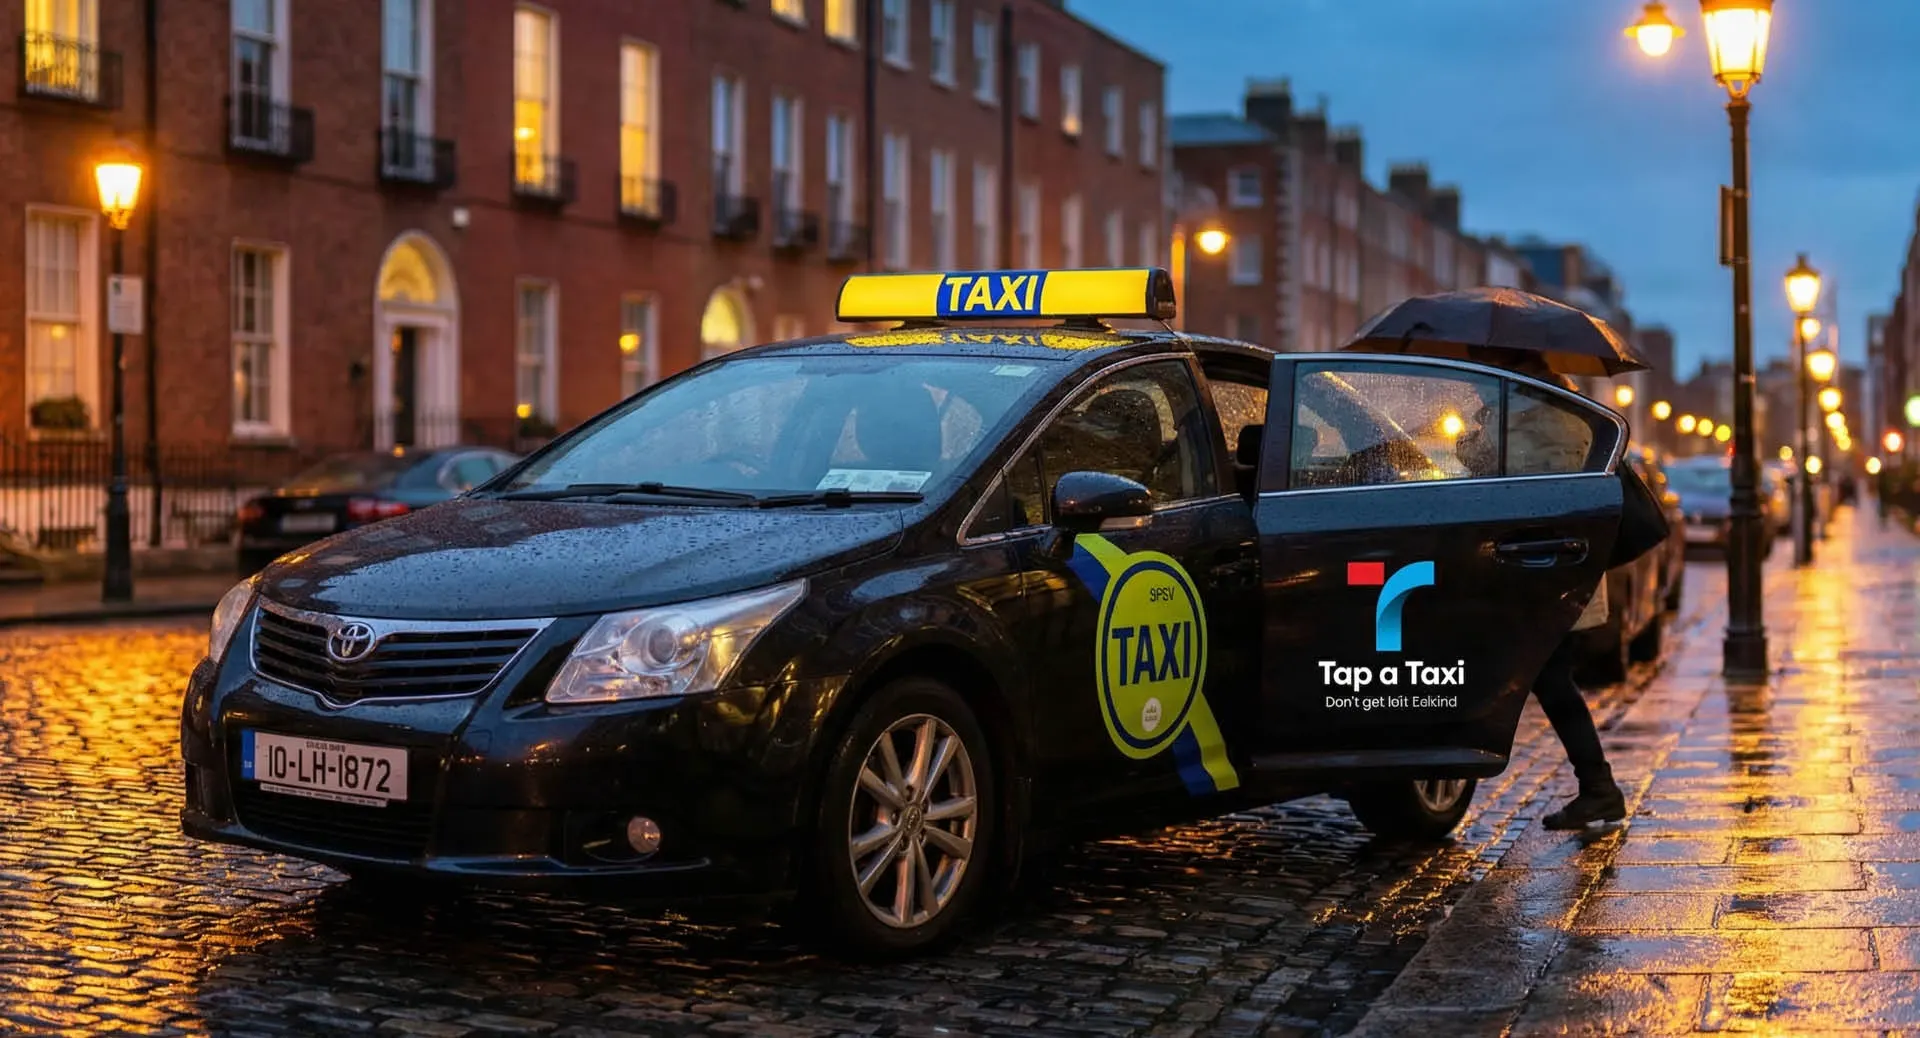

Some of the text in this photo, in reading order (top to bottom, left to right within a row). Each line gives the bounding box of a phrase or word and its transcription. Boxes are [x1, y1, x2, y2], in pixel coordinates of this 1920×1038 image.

[946, 275, 1039, 311] TAXI
[1111, 621, 1191, 686] TAXI
[1318, 659, 1465, 692] Tap a Taxi
[1325, 696, 1360, 708] Don't
[1362, 697, 1385, 711] get
[268, 745, 391, 793] 10-LH-1872
